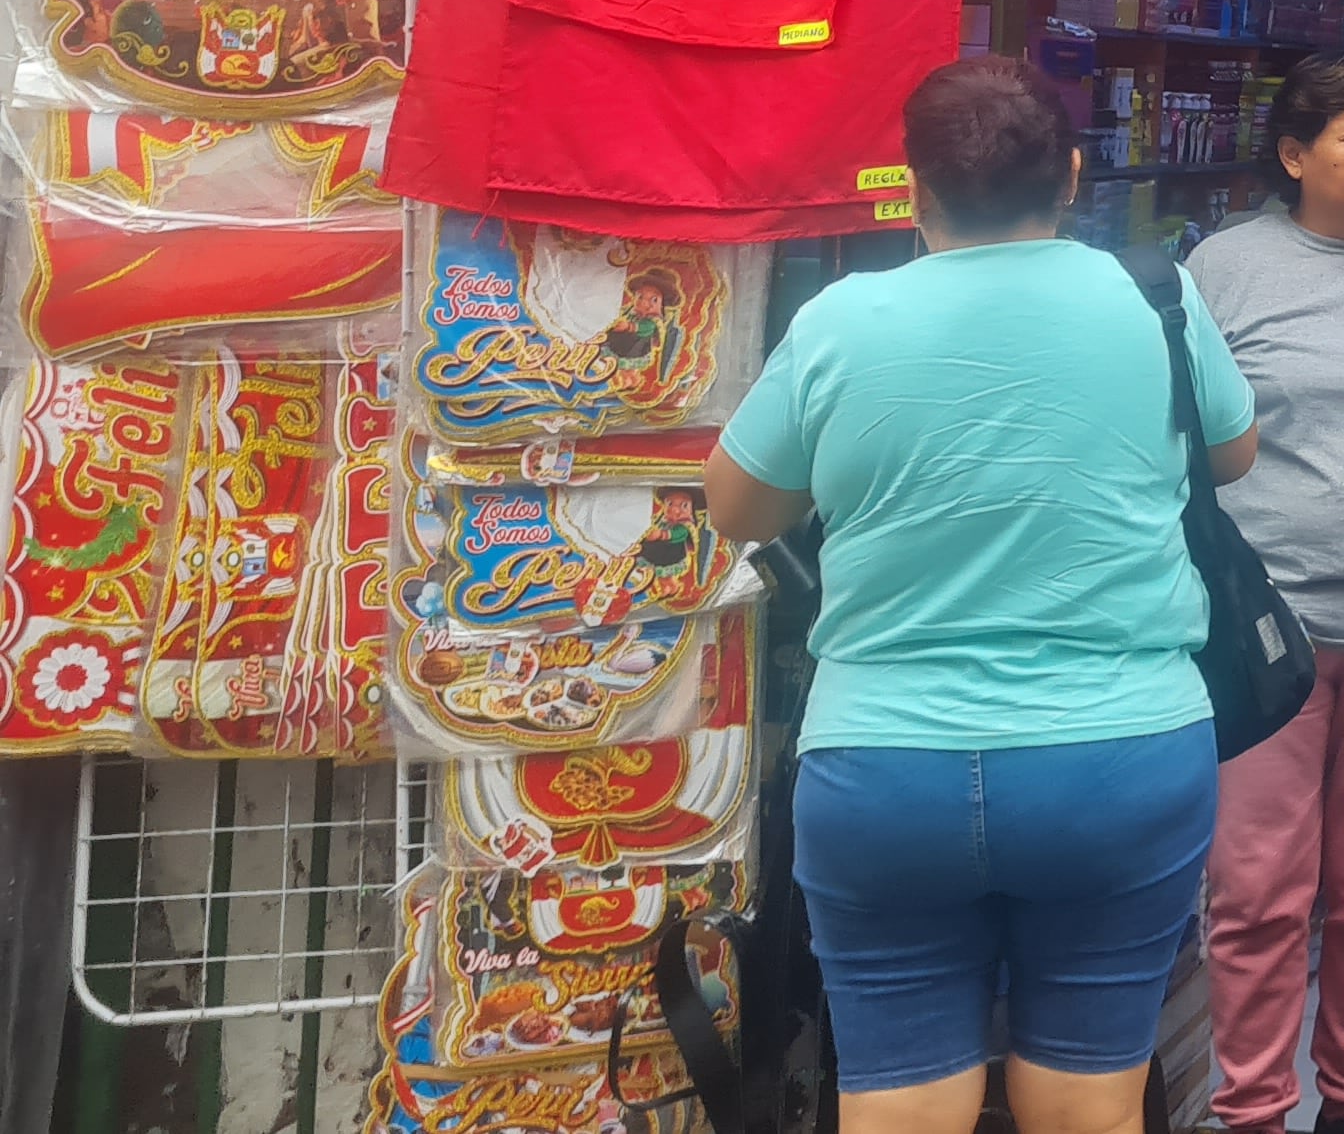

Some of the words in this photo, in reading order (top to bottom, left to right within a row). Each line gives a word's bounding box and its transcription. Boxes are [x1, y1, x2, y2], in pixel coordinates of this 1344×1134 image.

[781, 26, 826, 41] MEDIANO
[864, 172, 908, 187] REGLA
[881, 201, 910, 218] EXT
[444, 265, 512, 298] Todos
[434, 291, 521, 325] Somos
[426, 325, 618, 386] Perú
[471, 493, 541, 527] Todos
[465, 518, 552, 554] Somos
[463, 544, 655, 614] Perú
[464, 949, 512, 973] Viva
[516, 946, 540, 965] la
